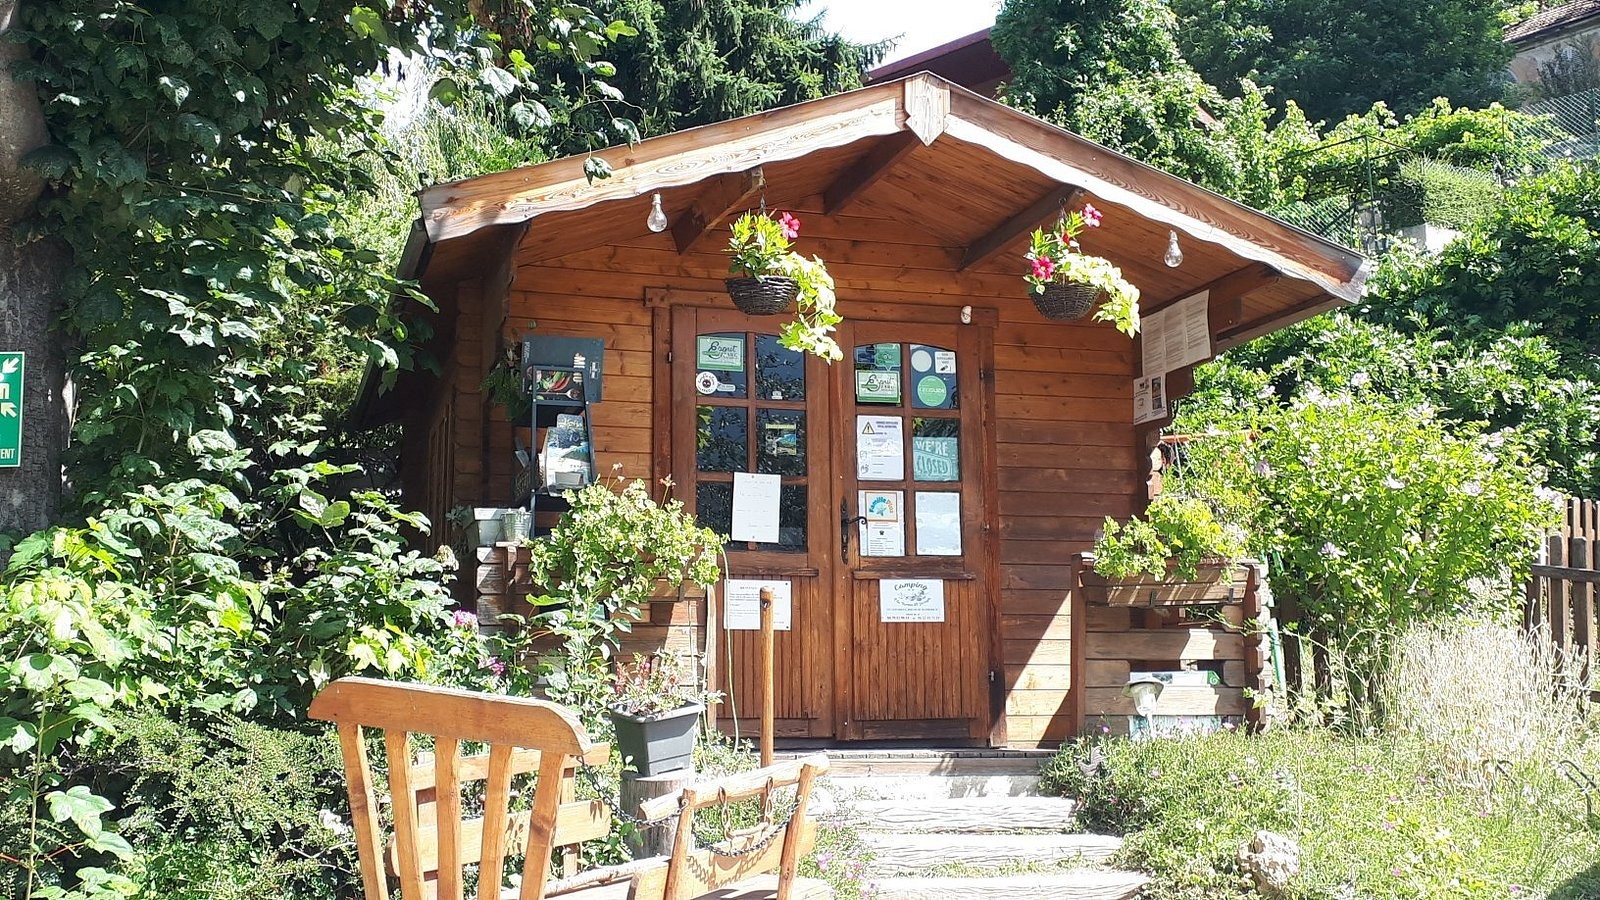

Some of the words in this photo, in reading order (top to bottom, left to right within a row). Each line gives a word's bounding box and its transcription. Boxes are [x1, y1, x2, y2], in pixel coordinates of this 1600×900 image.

[0, 448, 15, 460] ENT
[915, 439, 949, 457] WE'RE
[916, 455, 949, 475] CLOSED
[868, 496, 887, 513] Famille
[894, 582, 928, 591] Camping
